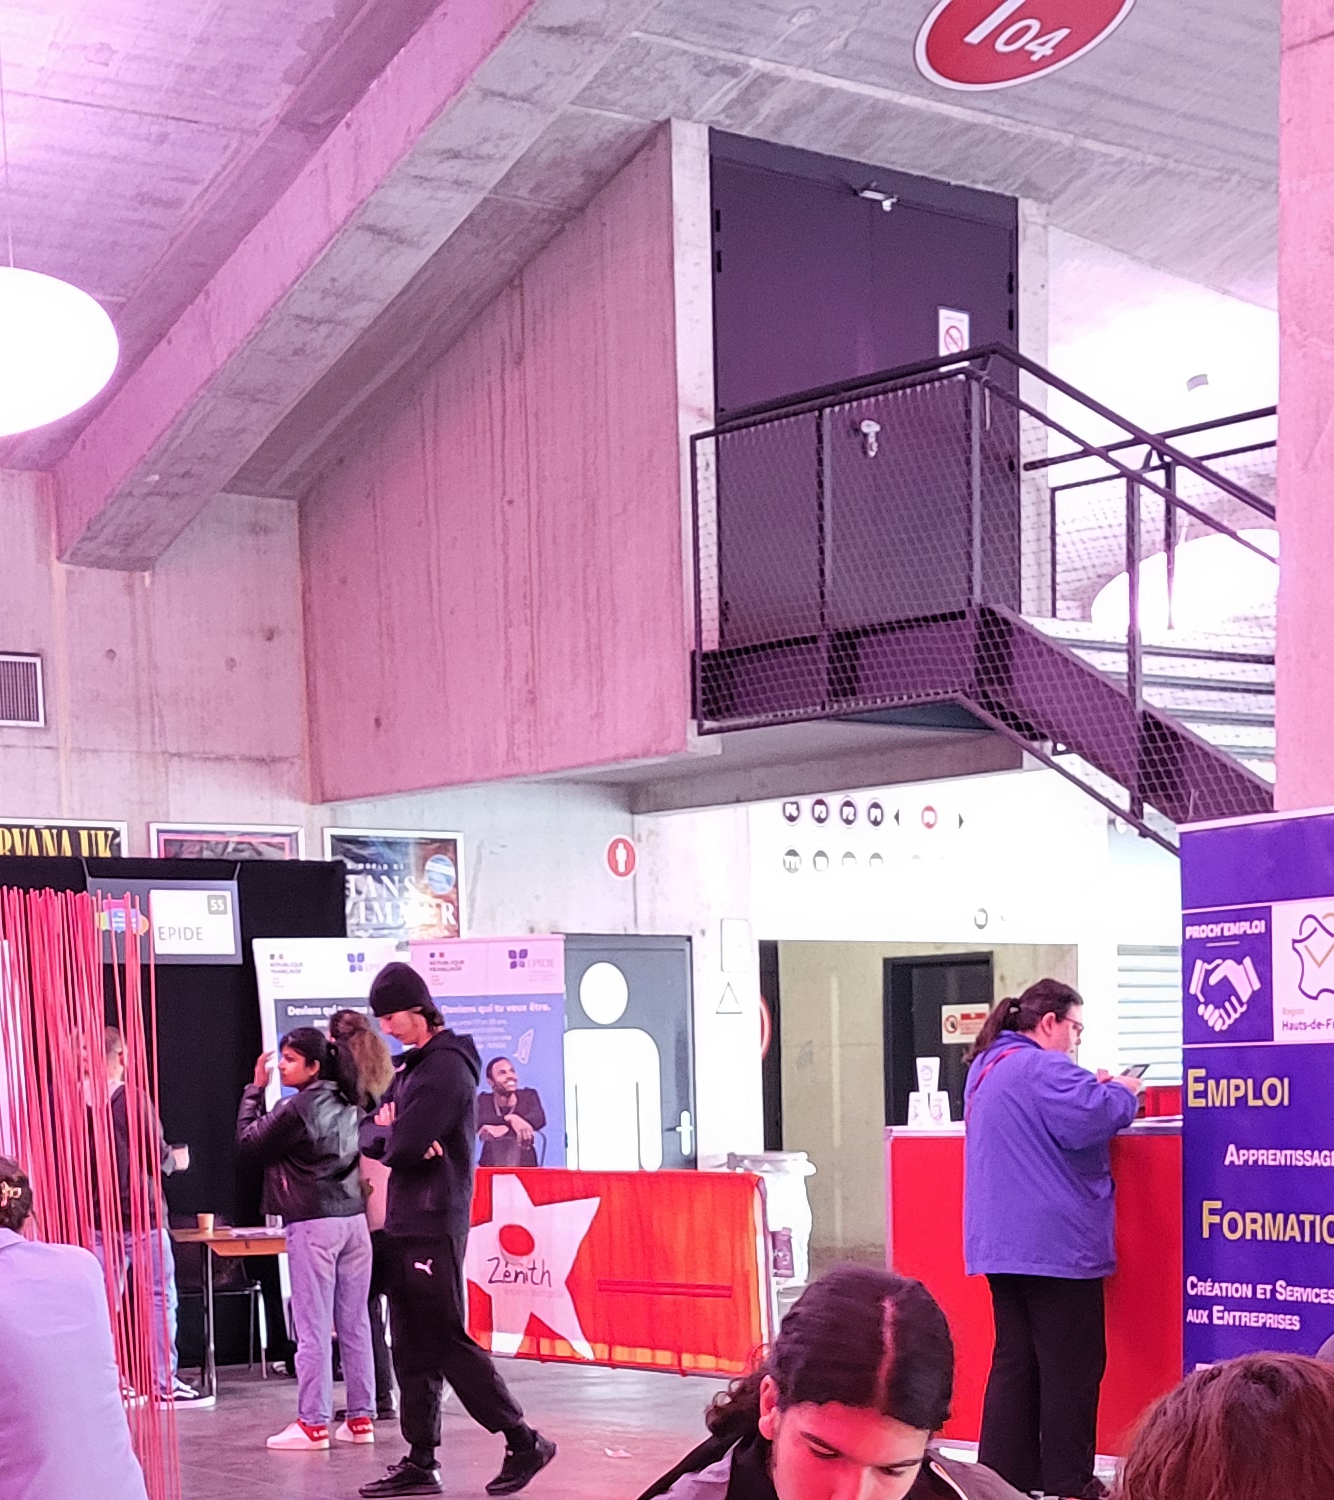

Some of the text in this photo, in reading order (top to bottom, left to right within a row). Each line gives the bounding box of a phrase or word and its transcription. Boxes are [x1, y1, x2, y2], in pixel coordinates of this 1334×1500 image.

[78, 829, 116, 857] UK
[209, 898, 225, 911] 55
[158, 926, 204, 941] EPIDE
[1185, 919, 1266, 940] PROCH'EMPLOI
[1187, 1068, 1290, 1108] EMPLOI
[486, 1256, 552, 1288] Zénith
[1186, 1275, 1253, 1299] CRÉATION
[1255, 1284, 1273, 1299] ET
[1186, 1305, 1301, 1331] AUX ENTREPRISES
